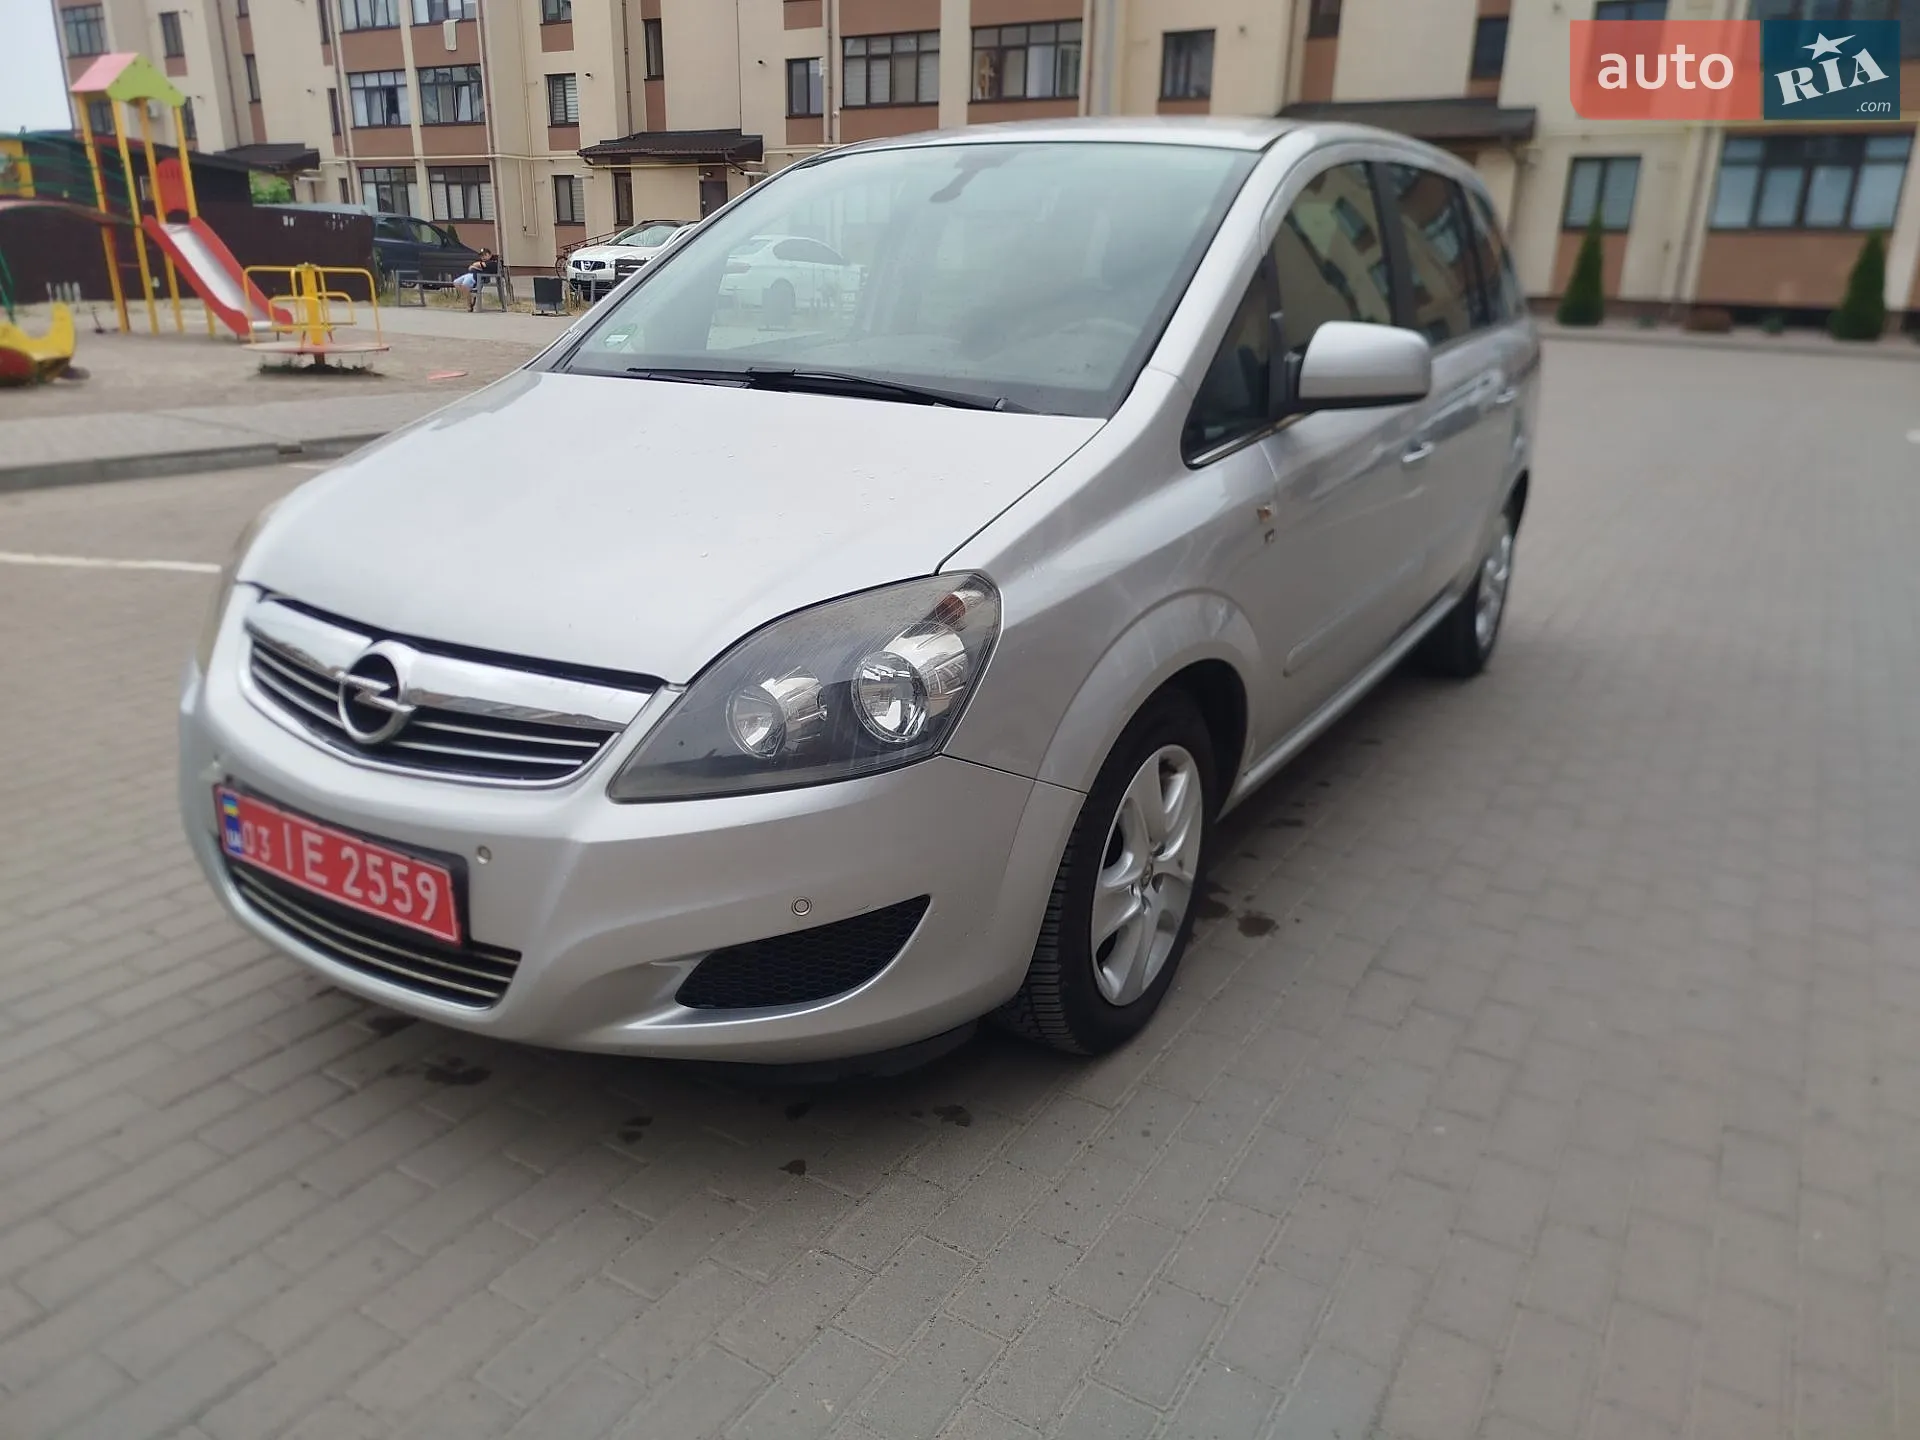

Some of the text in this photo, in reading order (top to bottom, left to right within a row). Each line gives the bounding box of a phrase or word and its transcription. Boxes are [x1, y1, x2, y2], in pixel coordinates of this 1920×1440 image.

[242, 820, 438, 921] 03 IE 2559
